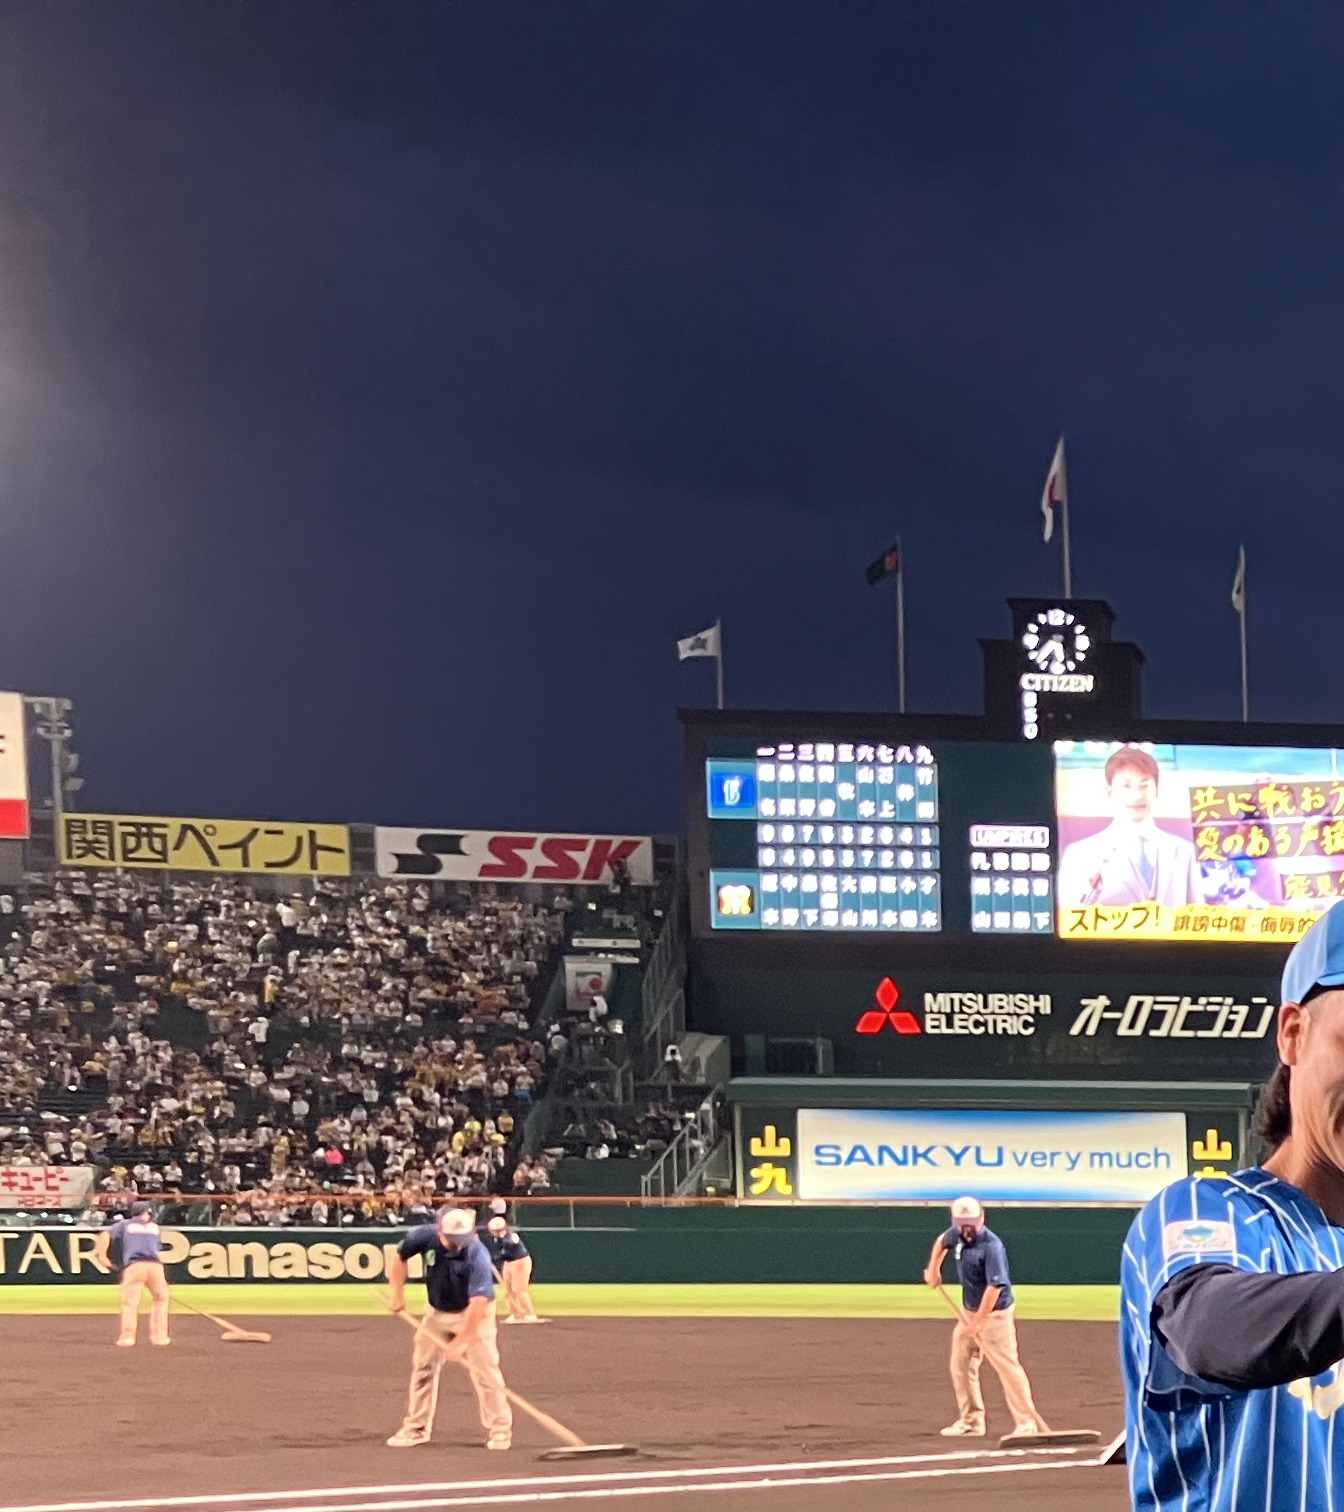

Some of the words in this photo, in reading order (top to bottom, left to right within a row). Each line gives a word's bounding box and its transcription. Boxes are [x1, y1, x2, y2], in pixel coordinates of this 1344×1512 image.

[1020, 673, 1094, 692] CITIZEN
[66, 820, 345, 869] 関西ペイント
[478, 836, 643, 880] SSK
[1070, 905, 1159, 932] ストップ!
[924, 992, 1051, 1015] MITSUBISHI
[1070, 996, 1275, 1038] オーロラビジョン
[924, 1014, 1035, 1035] ELECTRIC
[750, 1125, 792, 1195] 山九
[814, 1144, 1005, 1168] SANKYU
[1012, 1150, 1082, 1170] very
[1090, 1148, 1170, 1169] much
[1193, 1129, 1232, 1178] 山
